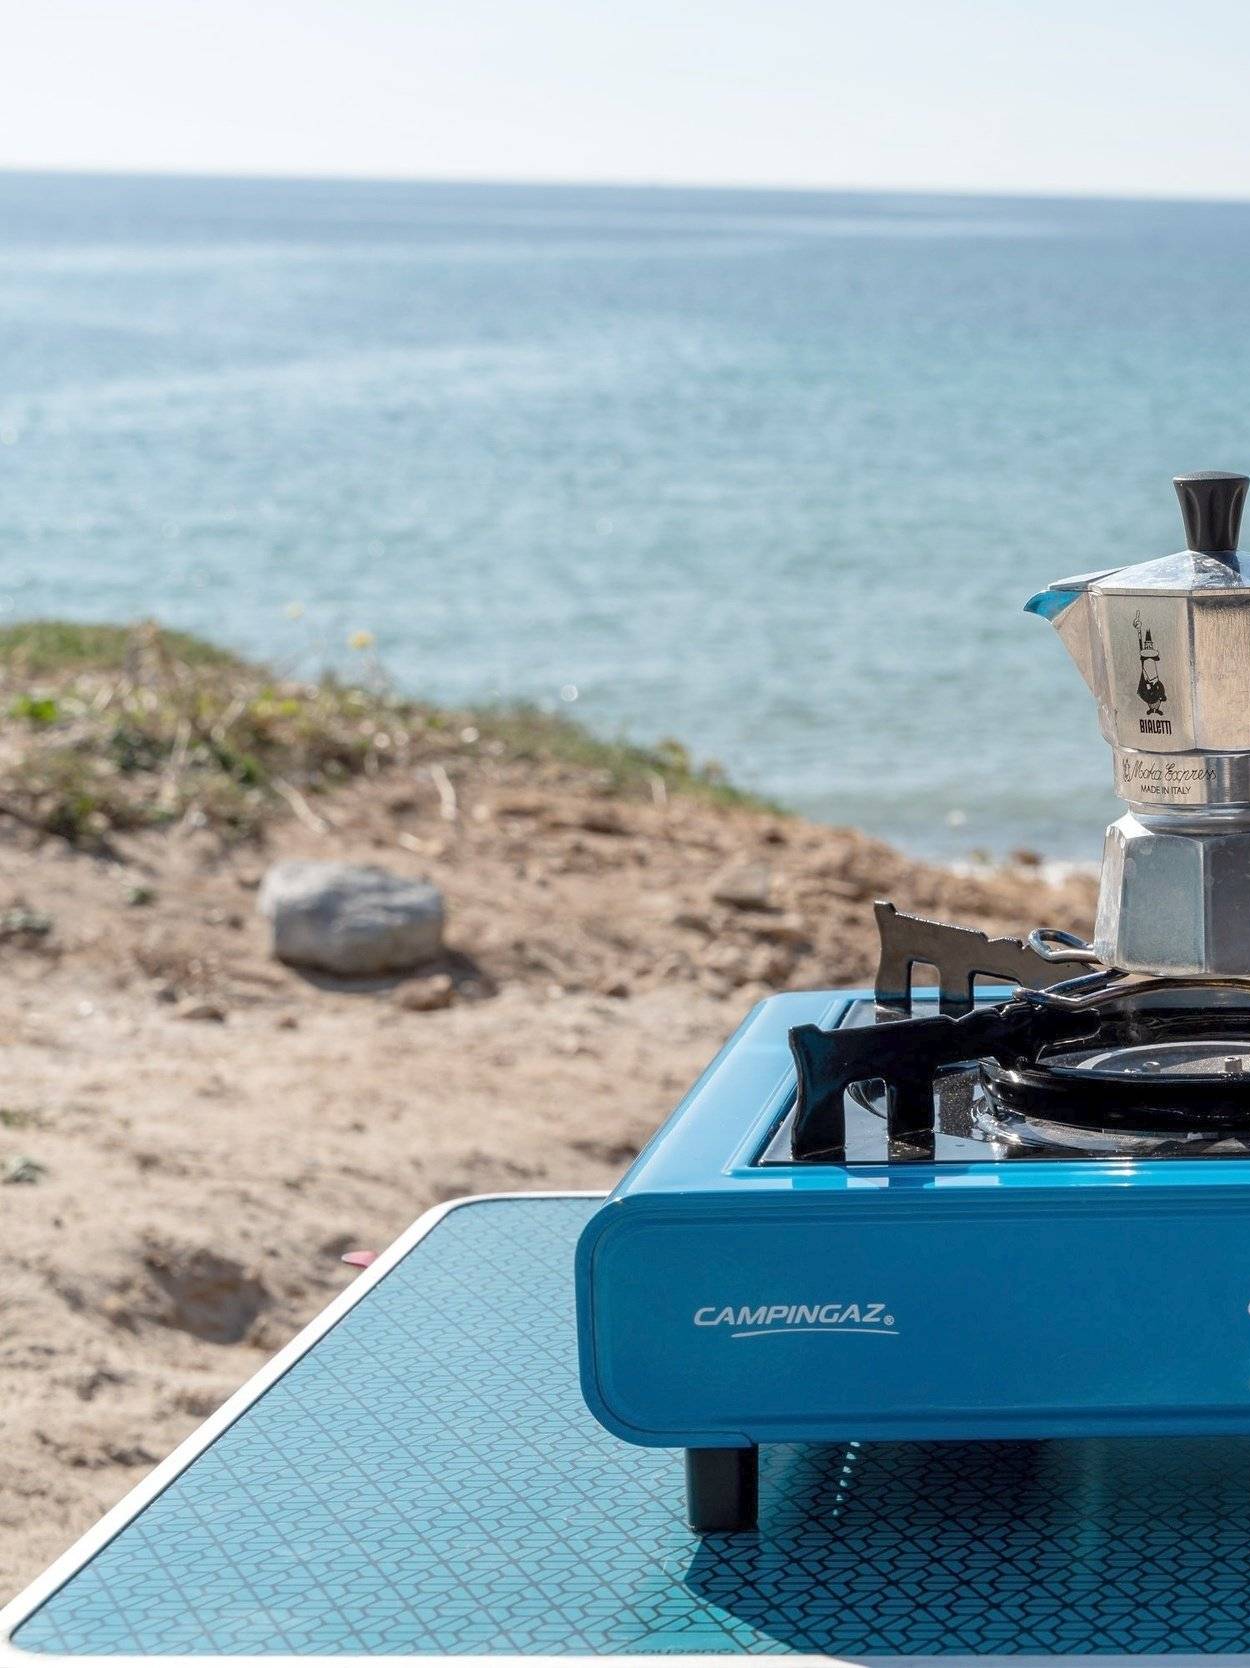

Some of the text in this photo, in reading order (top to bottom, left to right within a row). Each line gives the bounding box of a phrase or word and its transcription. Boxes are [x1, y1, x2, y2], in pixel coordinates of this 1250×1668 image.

[1141, 785, 1192, 795] MADE IN ITALY
